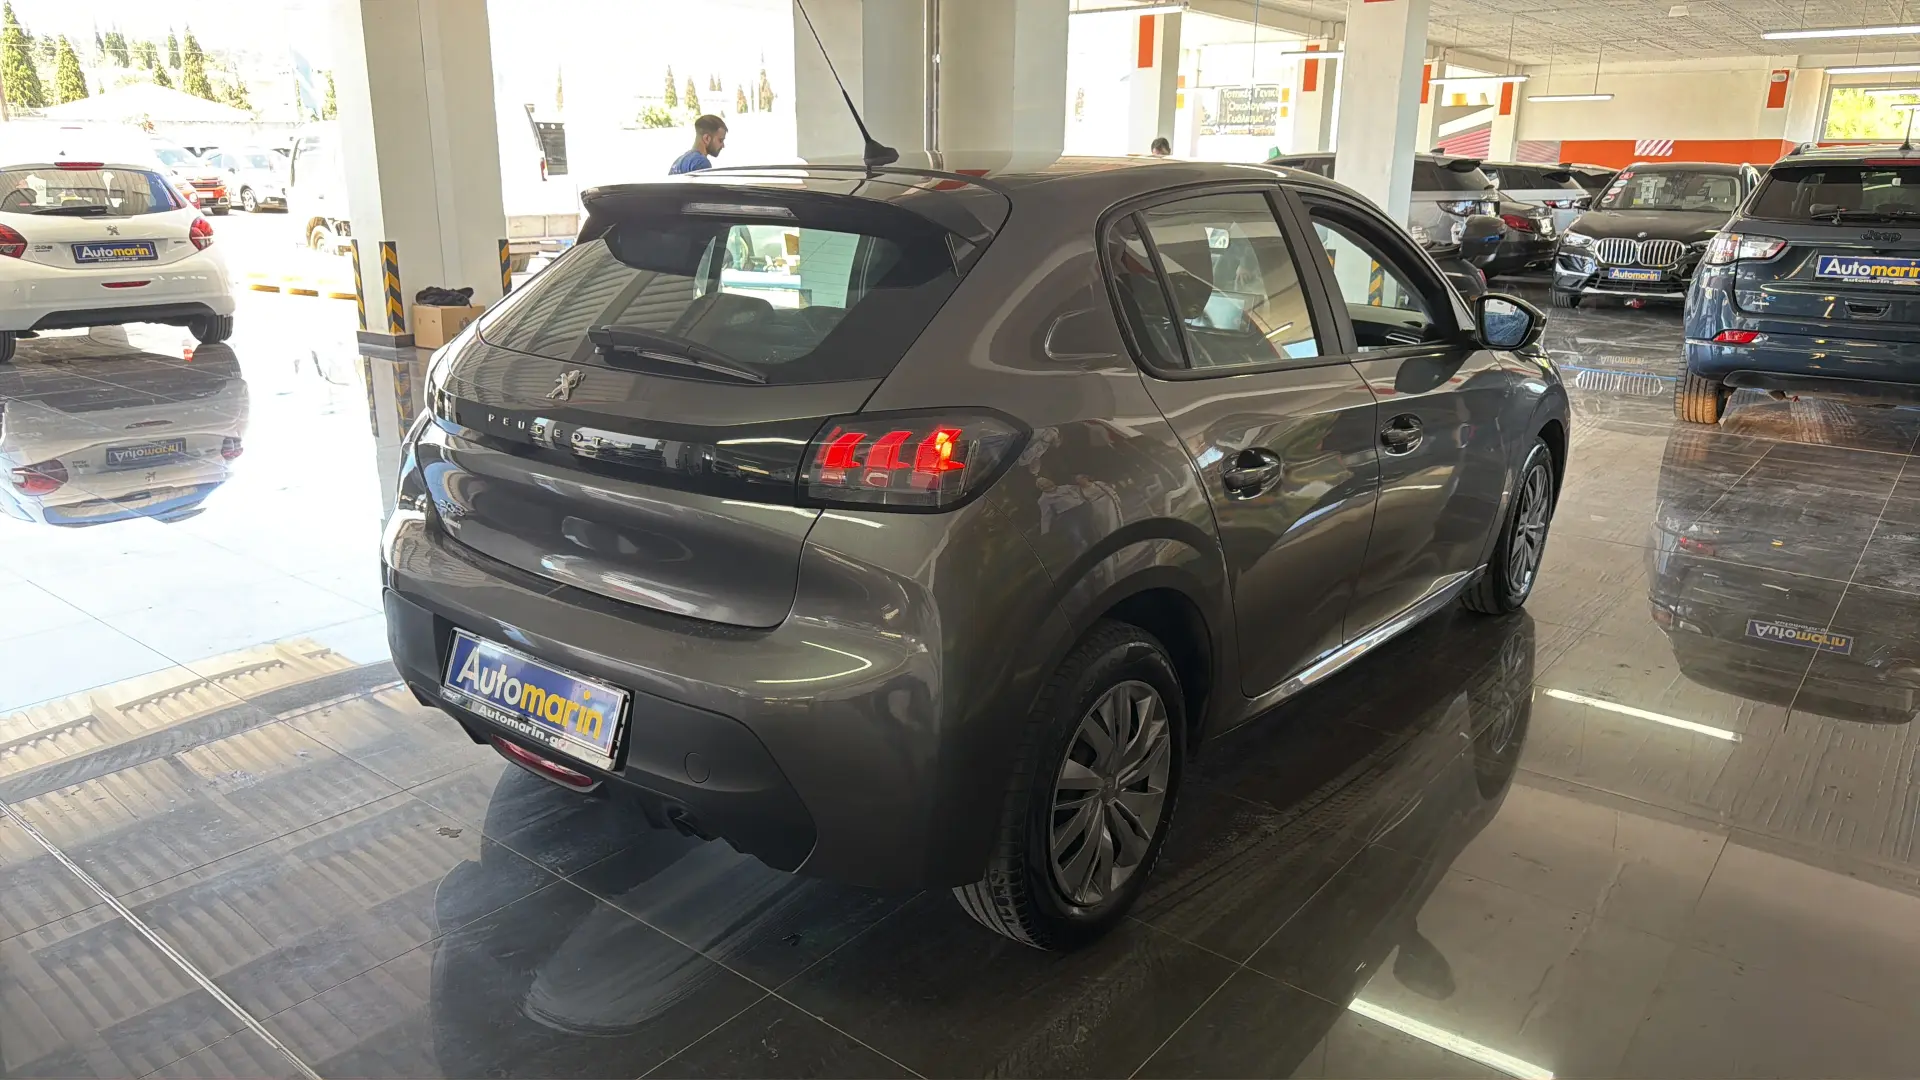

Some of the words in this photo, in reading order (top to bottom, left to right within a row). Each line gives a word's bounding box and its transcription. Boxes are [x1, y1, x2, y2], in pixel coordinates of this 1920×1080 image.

[1860, 230, 1902, 242] Jeep
[82, 244, 149, 258] Automarin
[1611, 269, 1658, 280] Automarin
[488, 413, 603, 446] PEUGEOT
[456, 646, 604, 740] Automarin
